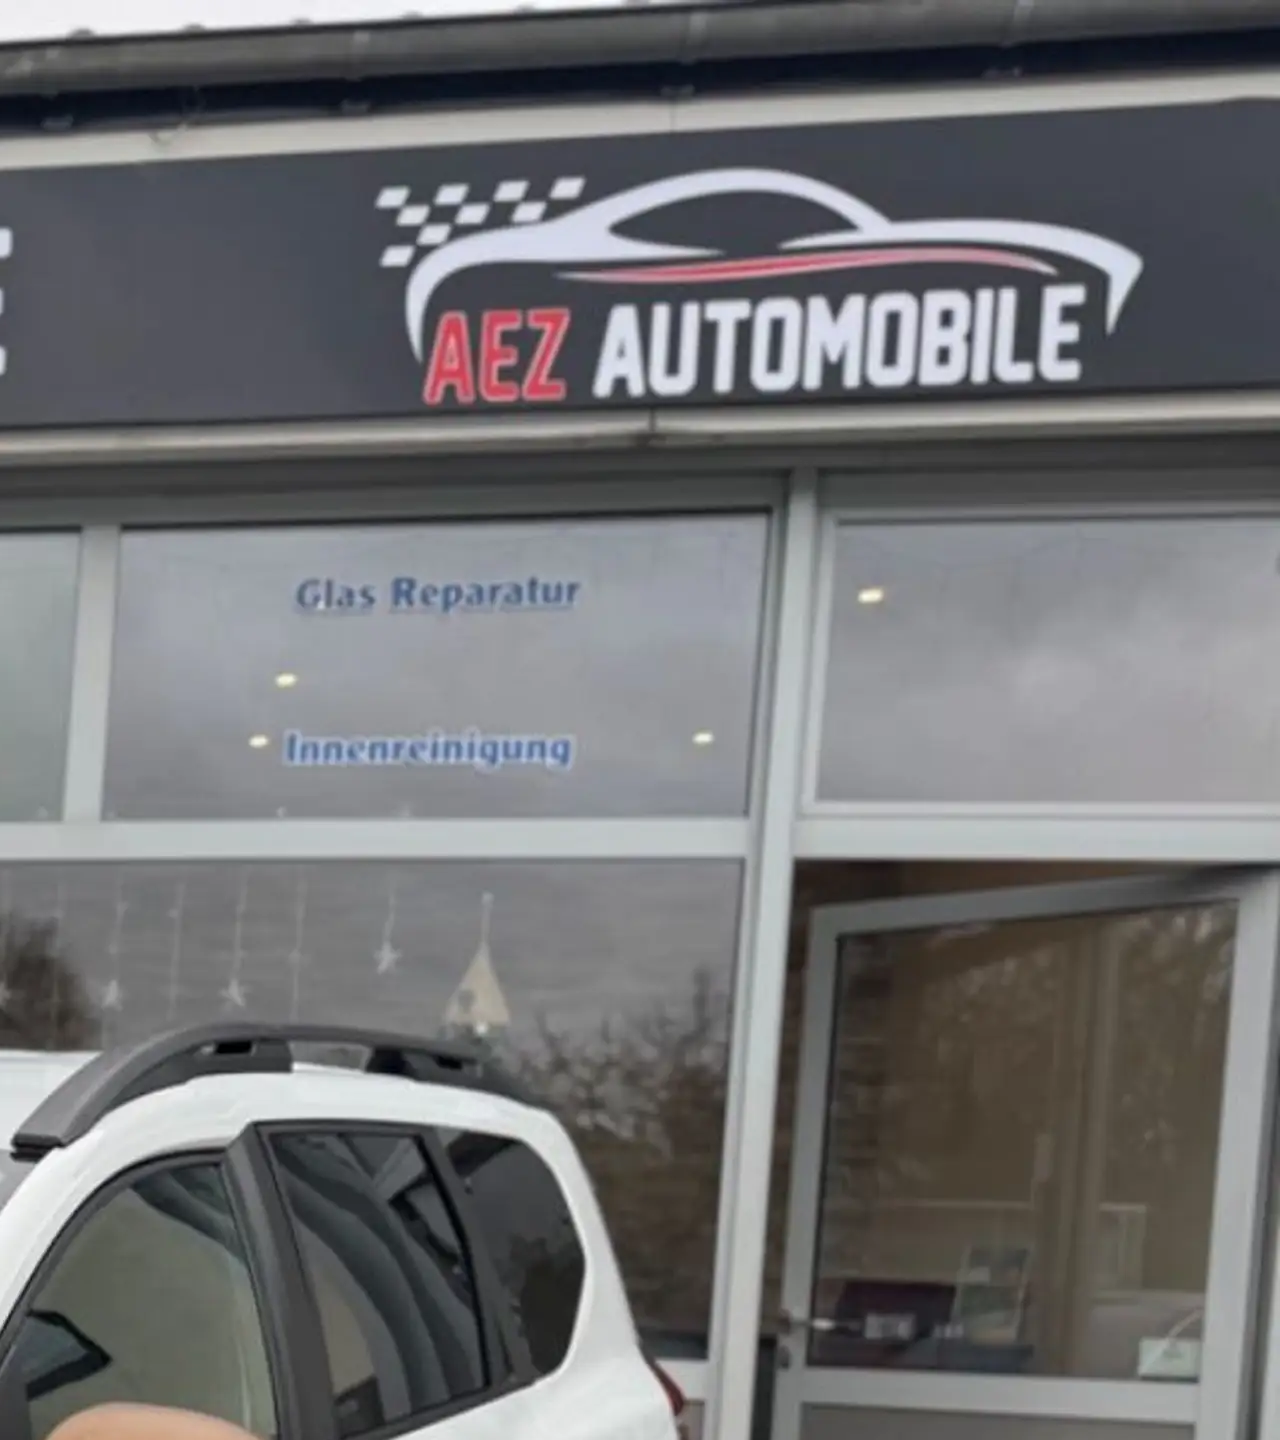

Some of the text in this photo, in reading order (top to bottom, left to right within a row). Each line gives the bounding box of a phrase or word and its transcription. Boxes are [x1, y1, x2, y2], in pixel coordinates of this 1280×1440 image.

[422, 284, 1088, 405] AEZ AUTOMOBILE
[295, 575, 581, 612] Glas Reparatur
[285, 730, 573, 770] Innenreinigung
